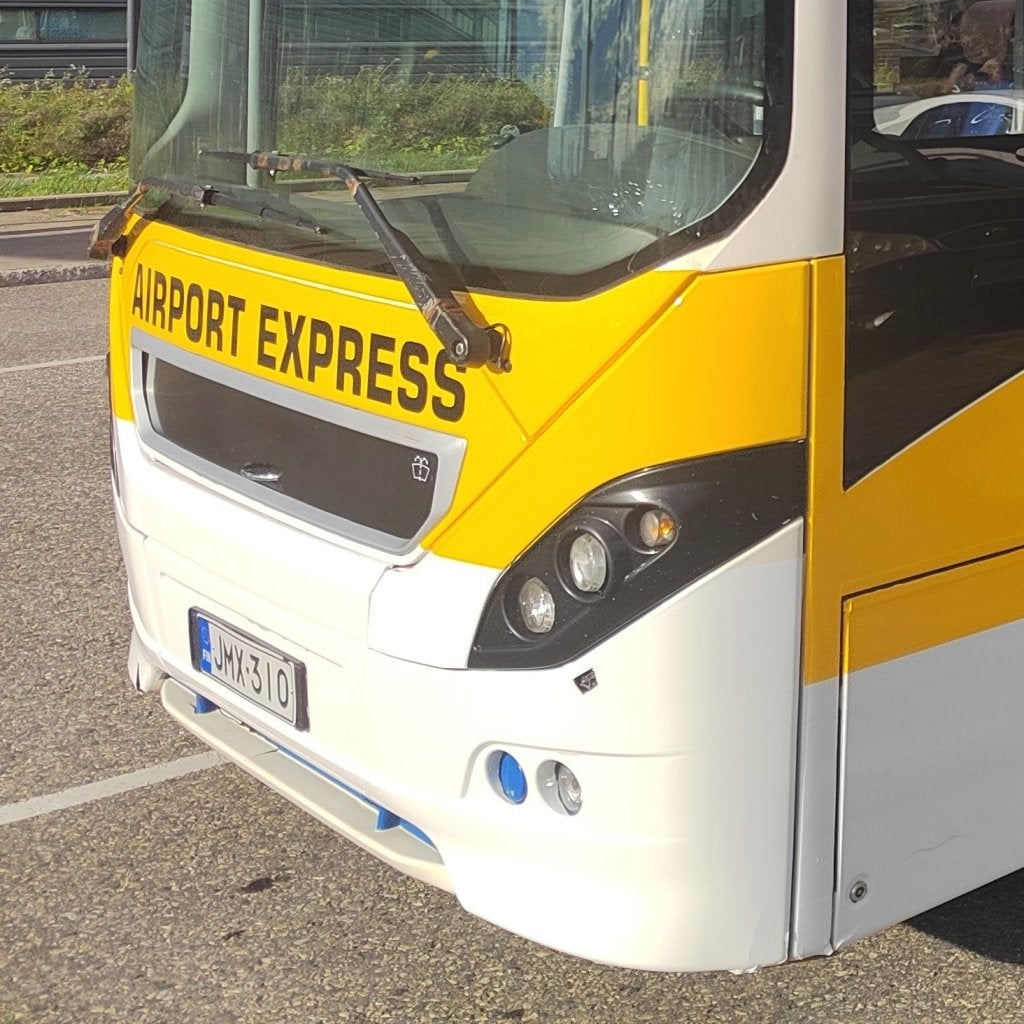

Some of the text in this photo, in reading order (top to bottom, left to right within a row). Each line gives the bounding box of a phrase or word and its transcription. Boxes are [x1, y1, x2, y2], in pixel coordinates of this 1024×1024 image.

[132, 263, 467, 423] AIRPORT EXPRESS
[214, 634, 289, 709] JMX-310
